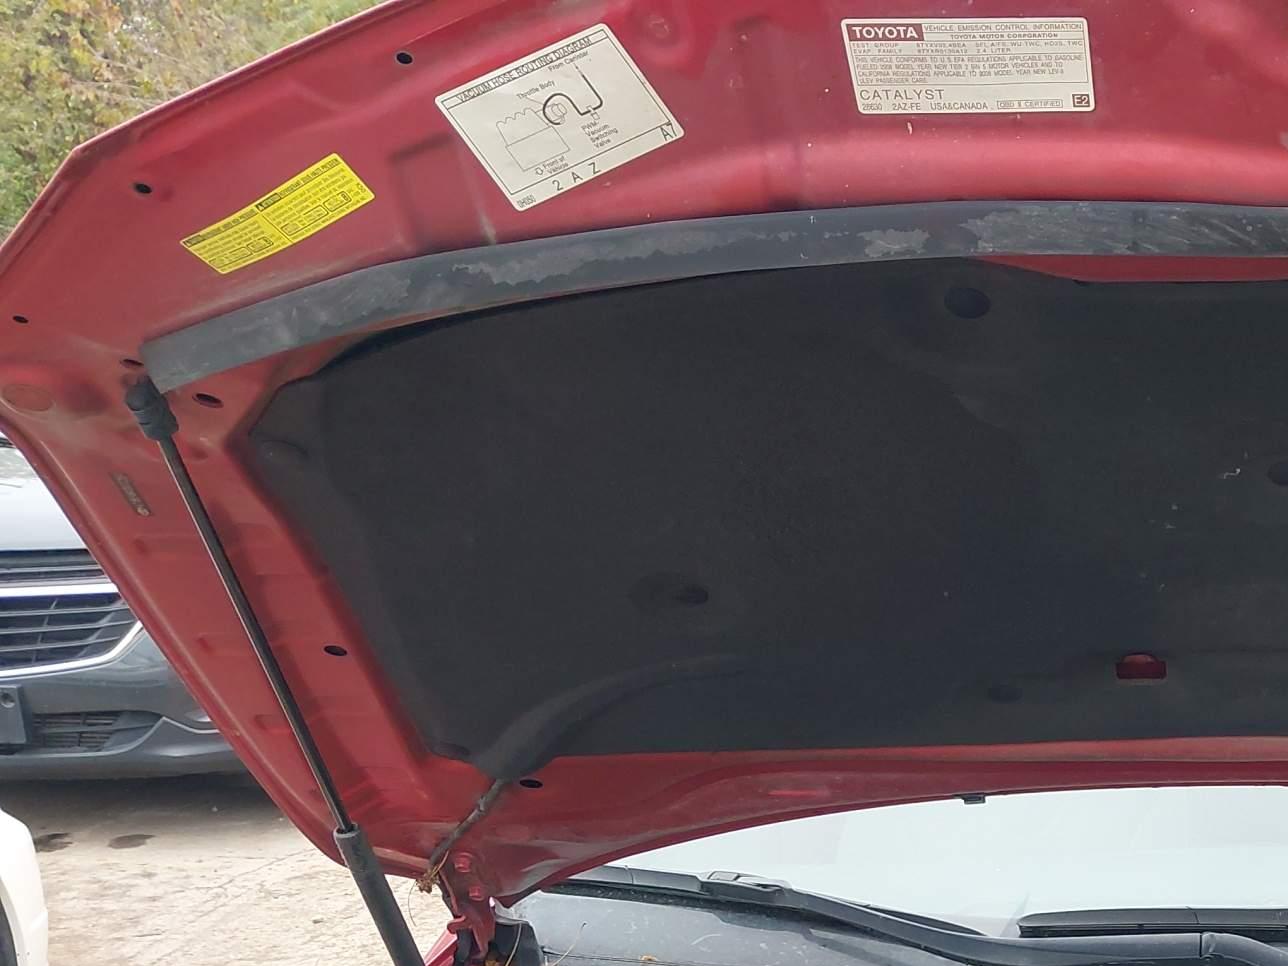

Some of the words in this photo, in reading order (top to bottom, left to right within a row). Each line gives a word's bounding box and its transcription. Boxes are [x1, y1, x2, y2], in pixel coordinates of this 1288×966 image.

[852, 26, 919, 39] TOYOTA
[924, 24, 954, 32] VEHICLE
[994, 23, 1029, 31] CONTROL
[1032, 22, 1083, 30] INFORMATION
[456, 81, 493, 102] VACUUM
[491, 70, 518, 87] HOSE
[516, 55, 554, 77] ROUTING
[553, 36, 592, 60] DIAGRAM
[859, 89, 945, 100] CATALYST
[892, 102, 921, 111] 2AZ-FE
[929, 101, 989, 111] USA&CANADA
[1073, 96, 1090, 106] E2
[660, 123, 678, 142] A7
[552, 179, 564, 192] 2
[571, 170, 584, 184] A
[588, 161, 602, 175] Z
